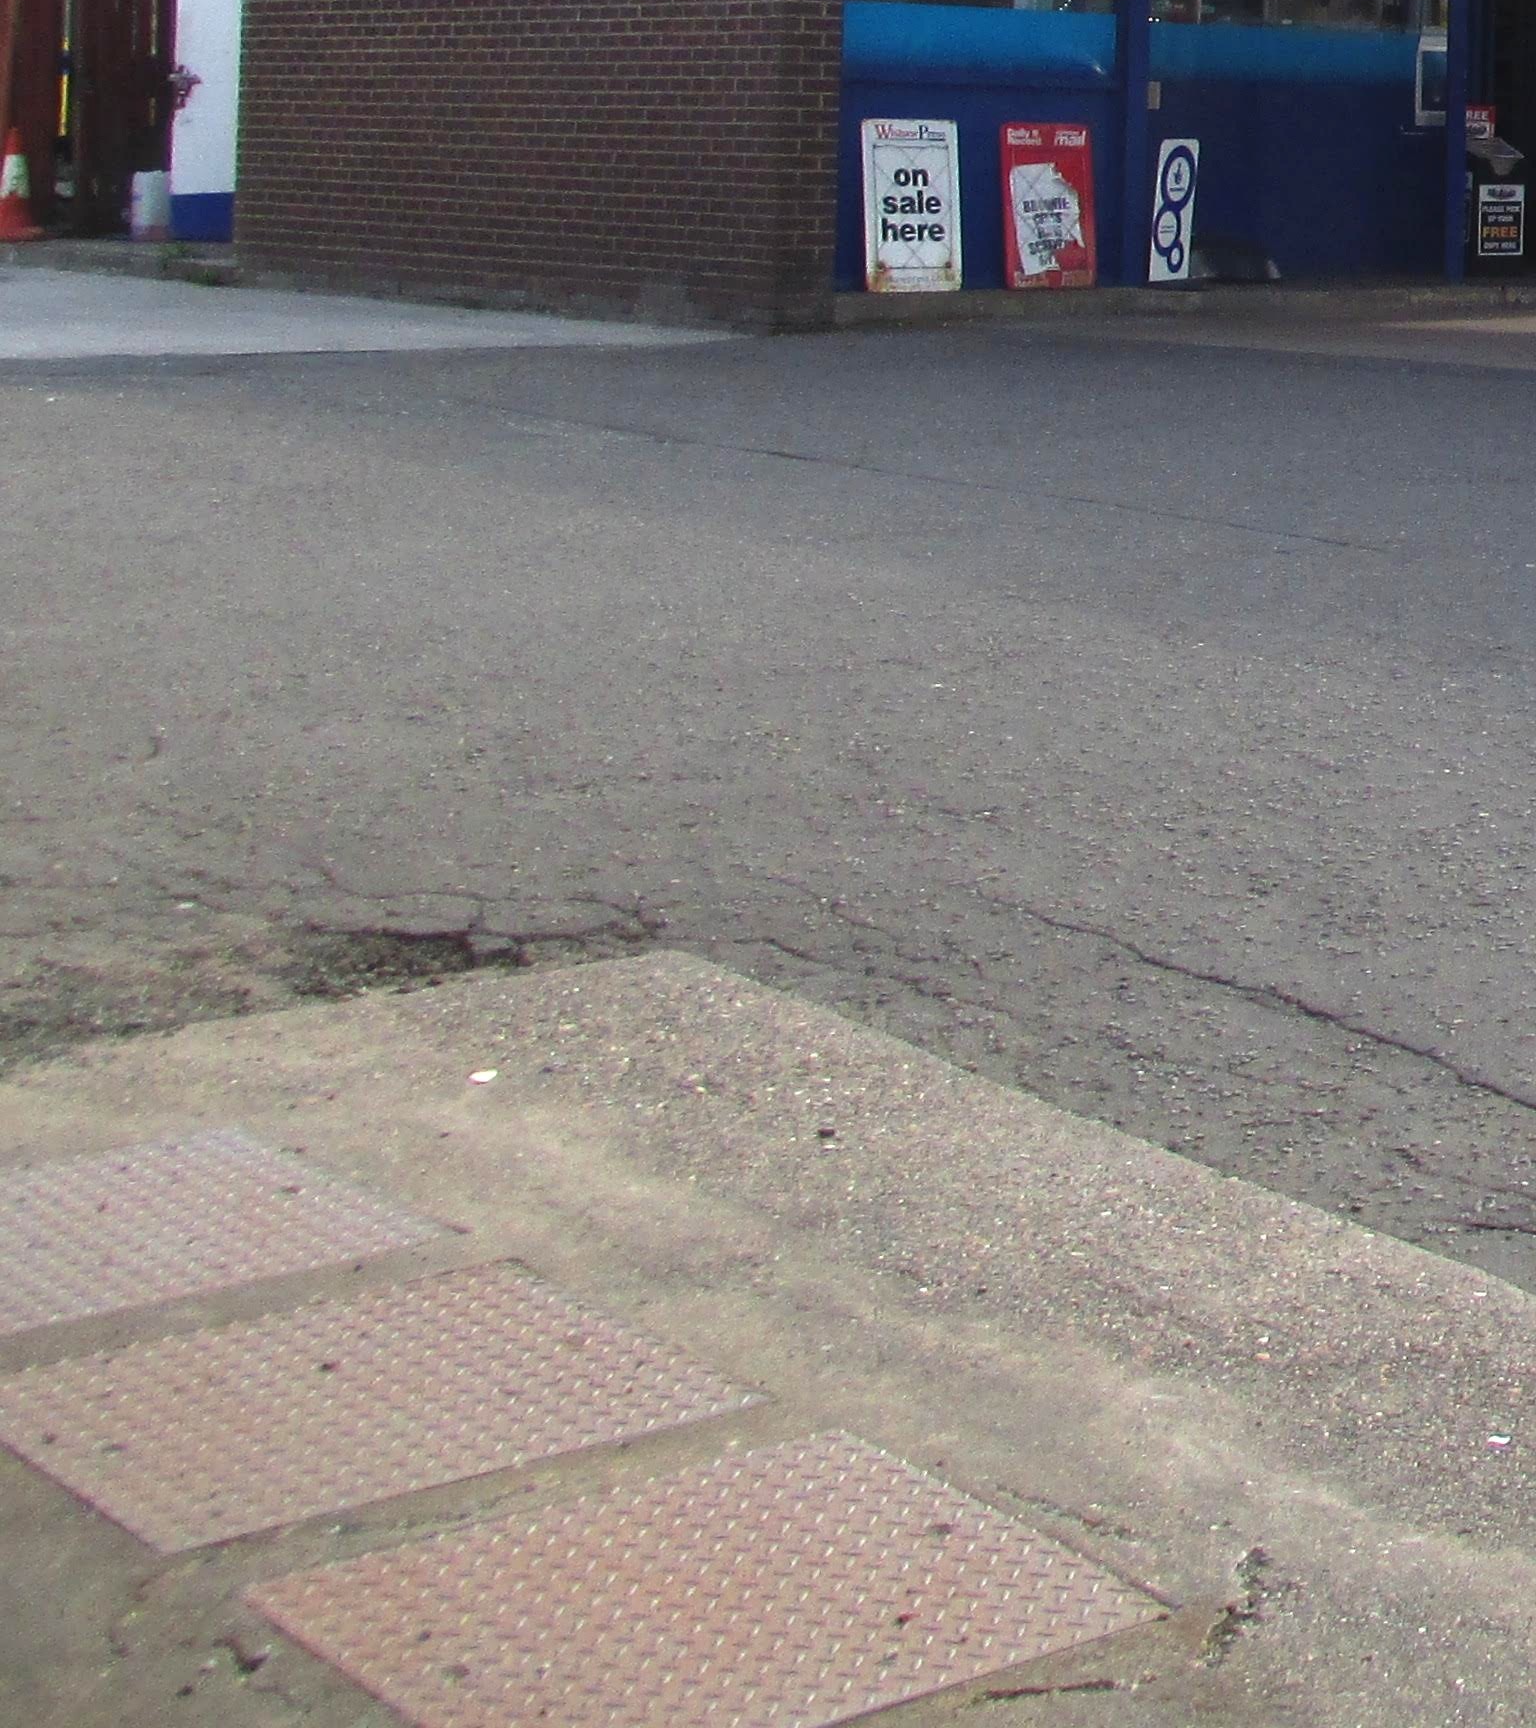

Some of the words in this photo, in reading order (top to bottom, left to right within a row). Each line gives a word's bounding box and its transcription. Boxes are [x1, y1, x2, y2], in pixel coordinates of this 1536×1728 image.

[1466, 110, 1490, 120] REE
[893, 168, 928, 188] on
[882, 190, 942, 215] sale
[881, 218, 945, 242] here
[1482, 226, 1519, 238] FREE
